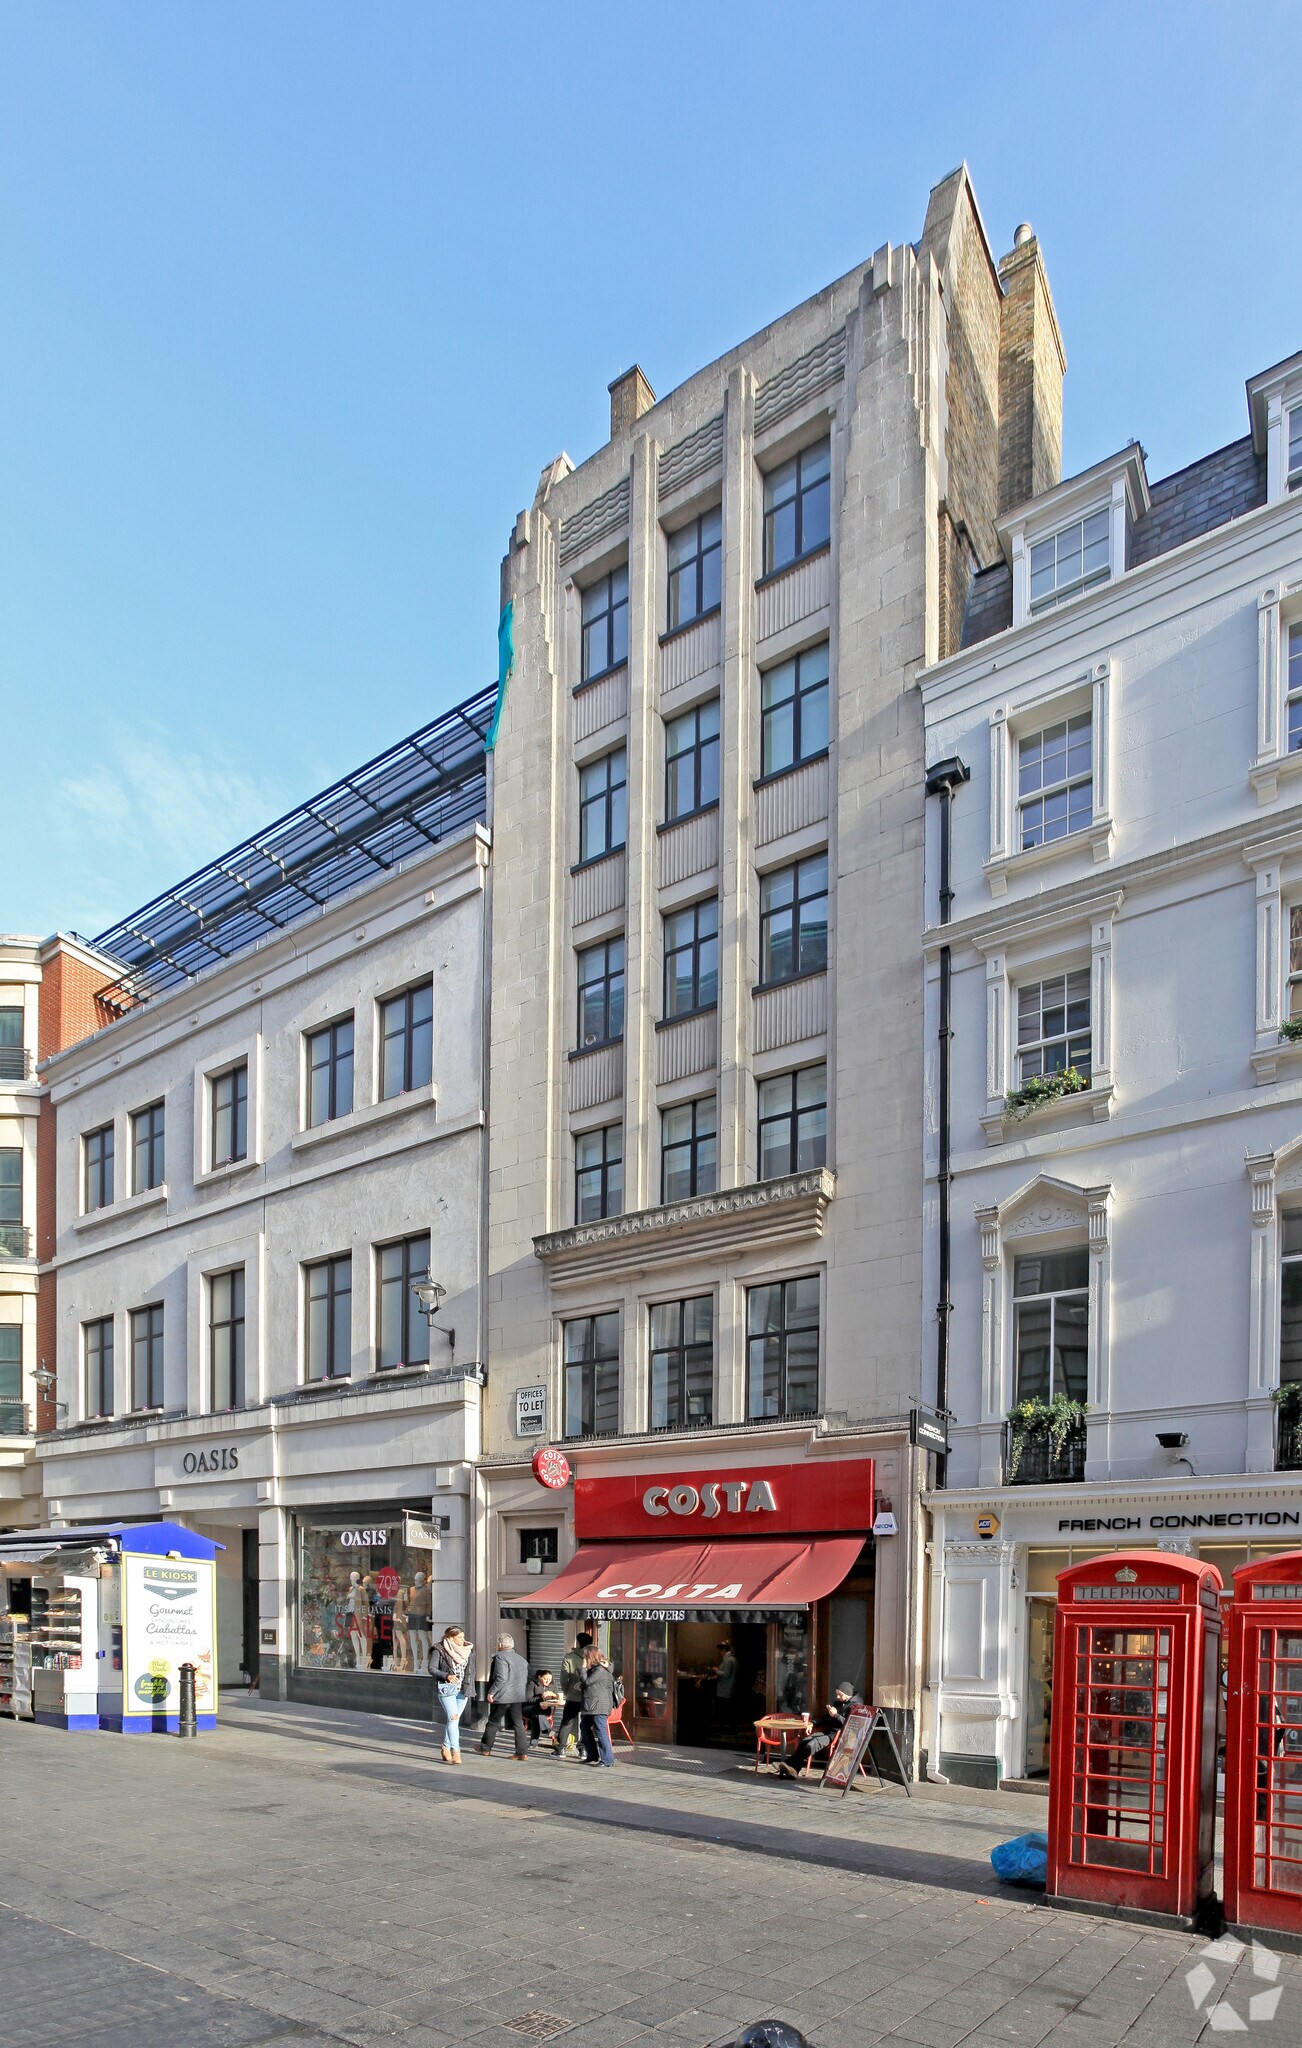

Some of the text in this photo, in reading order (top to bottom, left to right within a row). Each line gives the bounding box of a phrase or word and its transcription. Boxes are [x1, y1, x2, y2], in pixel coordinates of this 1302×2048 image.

[520, 1389, 543, 1399] OFFICES
[519, 1400, 544, 1412] TO LET
[918, 1427, 945, 1443] CONNECTION
[183, 1447, 239, 1474] OASIS
[543, 1452, 564, 1465] COSTA
[541, 1468, 565, 1487] COFFEE
[642, 1480, 777, 1518] COSTA
[1058, 1511, 1300, 1532] FRENCH CONNECTION
[341, 1529, 387, 1546] OASIS
[410, 1530, 438, 1541] OASIS
[533, 1537, 549, 1557] 11
[146, 1569, 194, 1581] LE KIOSK
[378, 1575, 398, 1590] 70%
[597, 1583, 743, 1599] COSTA
[1079, 1587, 1177, 1600] TELEPHONE
[149, 1603, 194, 1617] Gourmet
[368, 1605, 392, 1615] OASIS
[586, 1609, 685, 1621] FOR COFFEE LOVERS
[146, 1622, 198, 1635] Ciabattas
[334, 1613, 392, 1640] SALE
